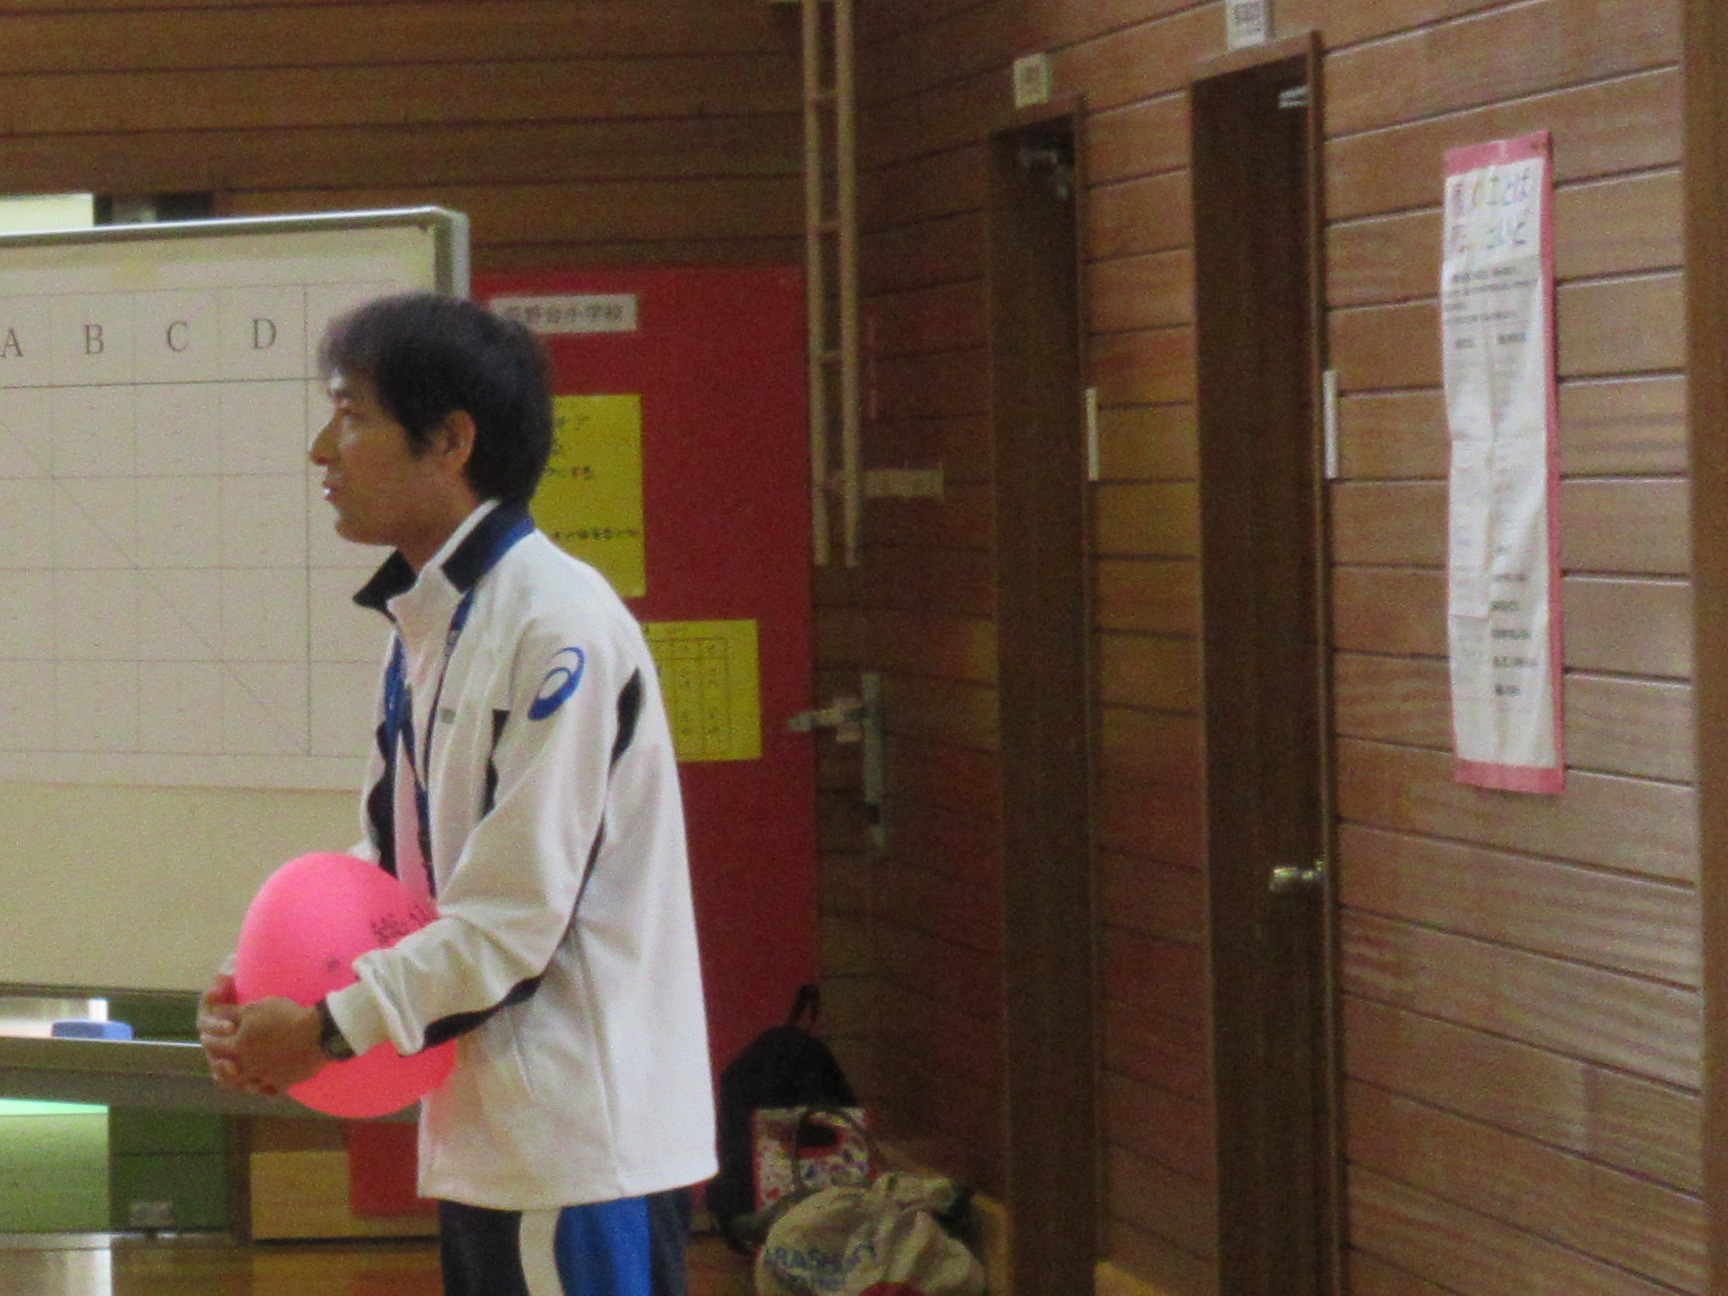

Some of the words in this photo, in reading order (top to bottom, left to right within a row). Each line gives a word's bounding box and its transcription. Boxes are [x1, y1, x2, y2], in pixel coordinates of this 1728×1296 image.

[0, 327, 25, 359] A
[84, 324, 105, 356] B
[166, 321, 189, 354] C
[252, 318, 278, 351] D
